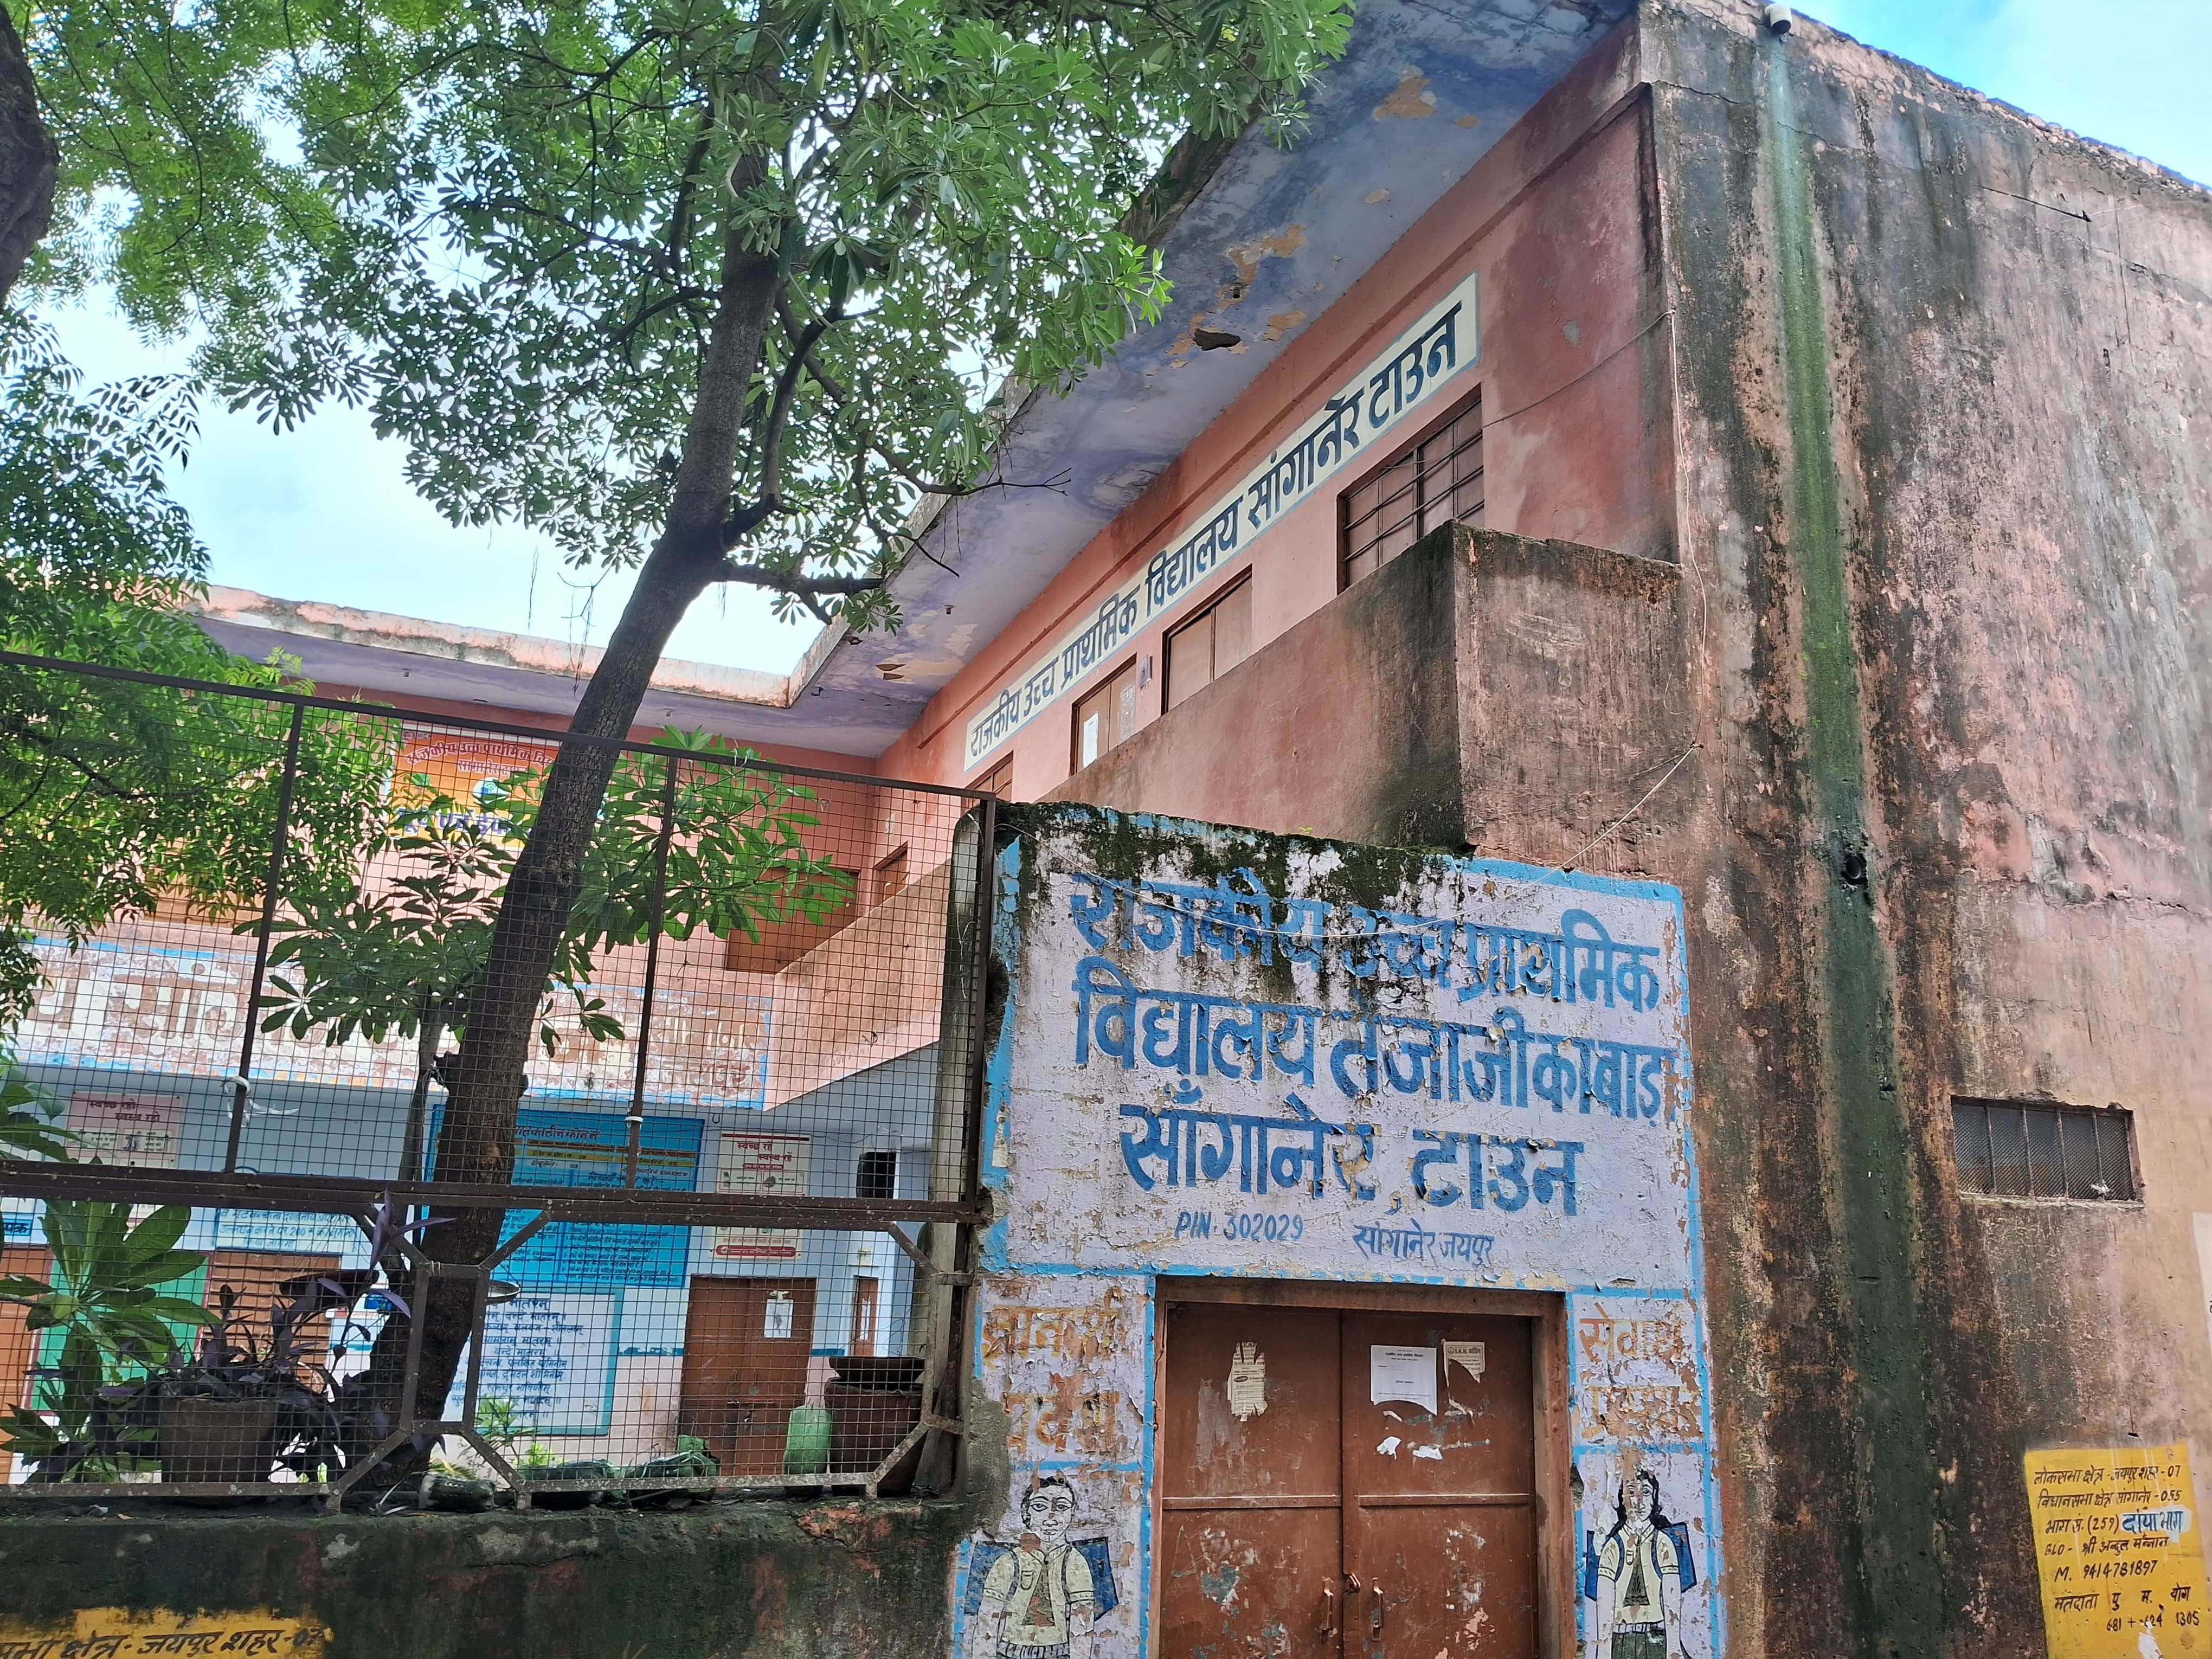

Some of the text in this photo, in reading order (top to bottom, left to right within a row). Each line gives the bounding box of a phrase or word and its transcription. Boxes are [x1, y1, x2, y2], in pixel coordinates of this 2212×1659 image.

[970, 689, 1021, 757] राजकीय
[1024, 655, 1059, 717] उच्च
[1060, 584, 1140, 691] प्राथमिक
[1144, 494, 1244, 617] विद्यालय
[1248, 386, 1365, 530] सांगानेर
[1368, 300, 1462, 429] टाउन
[1457, 909, 1660, 1013] प्राथमिक
[1071, 955, 1323, 1086] विद्यालय
[1411, 1128, 1585, 1216] टाउन
[1224, 1212, 1303, 1240] 302029
[1439, 1231, 1495, 1264] जयपुर
[2046, 1519, 2072, 1534] भाग
[2087, 1514, 2119, 1535] (259)
[2159, 1510, 2184, 1533] भाग
[2082, 1536, 2097, 1557] श्री
[2175, 1610, 2200, 1626] 1305
